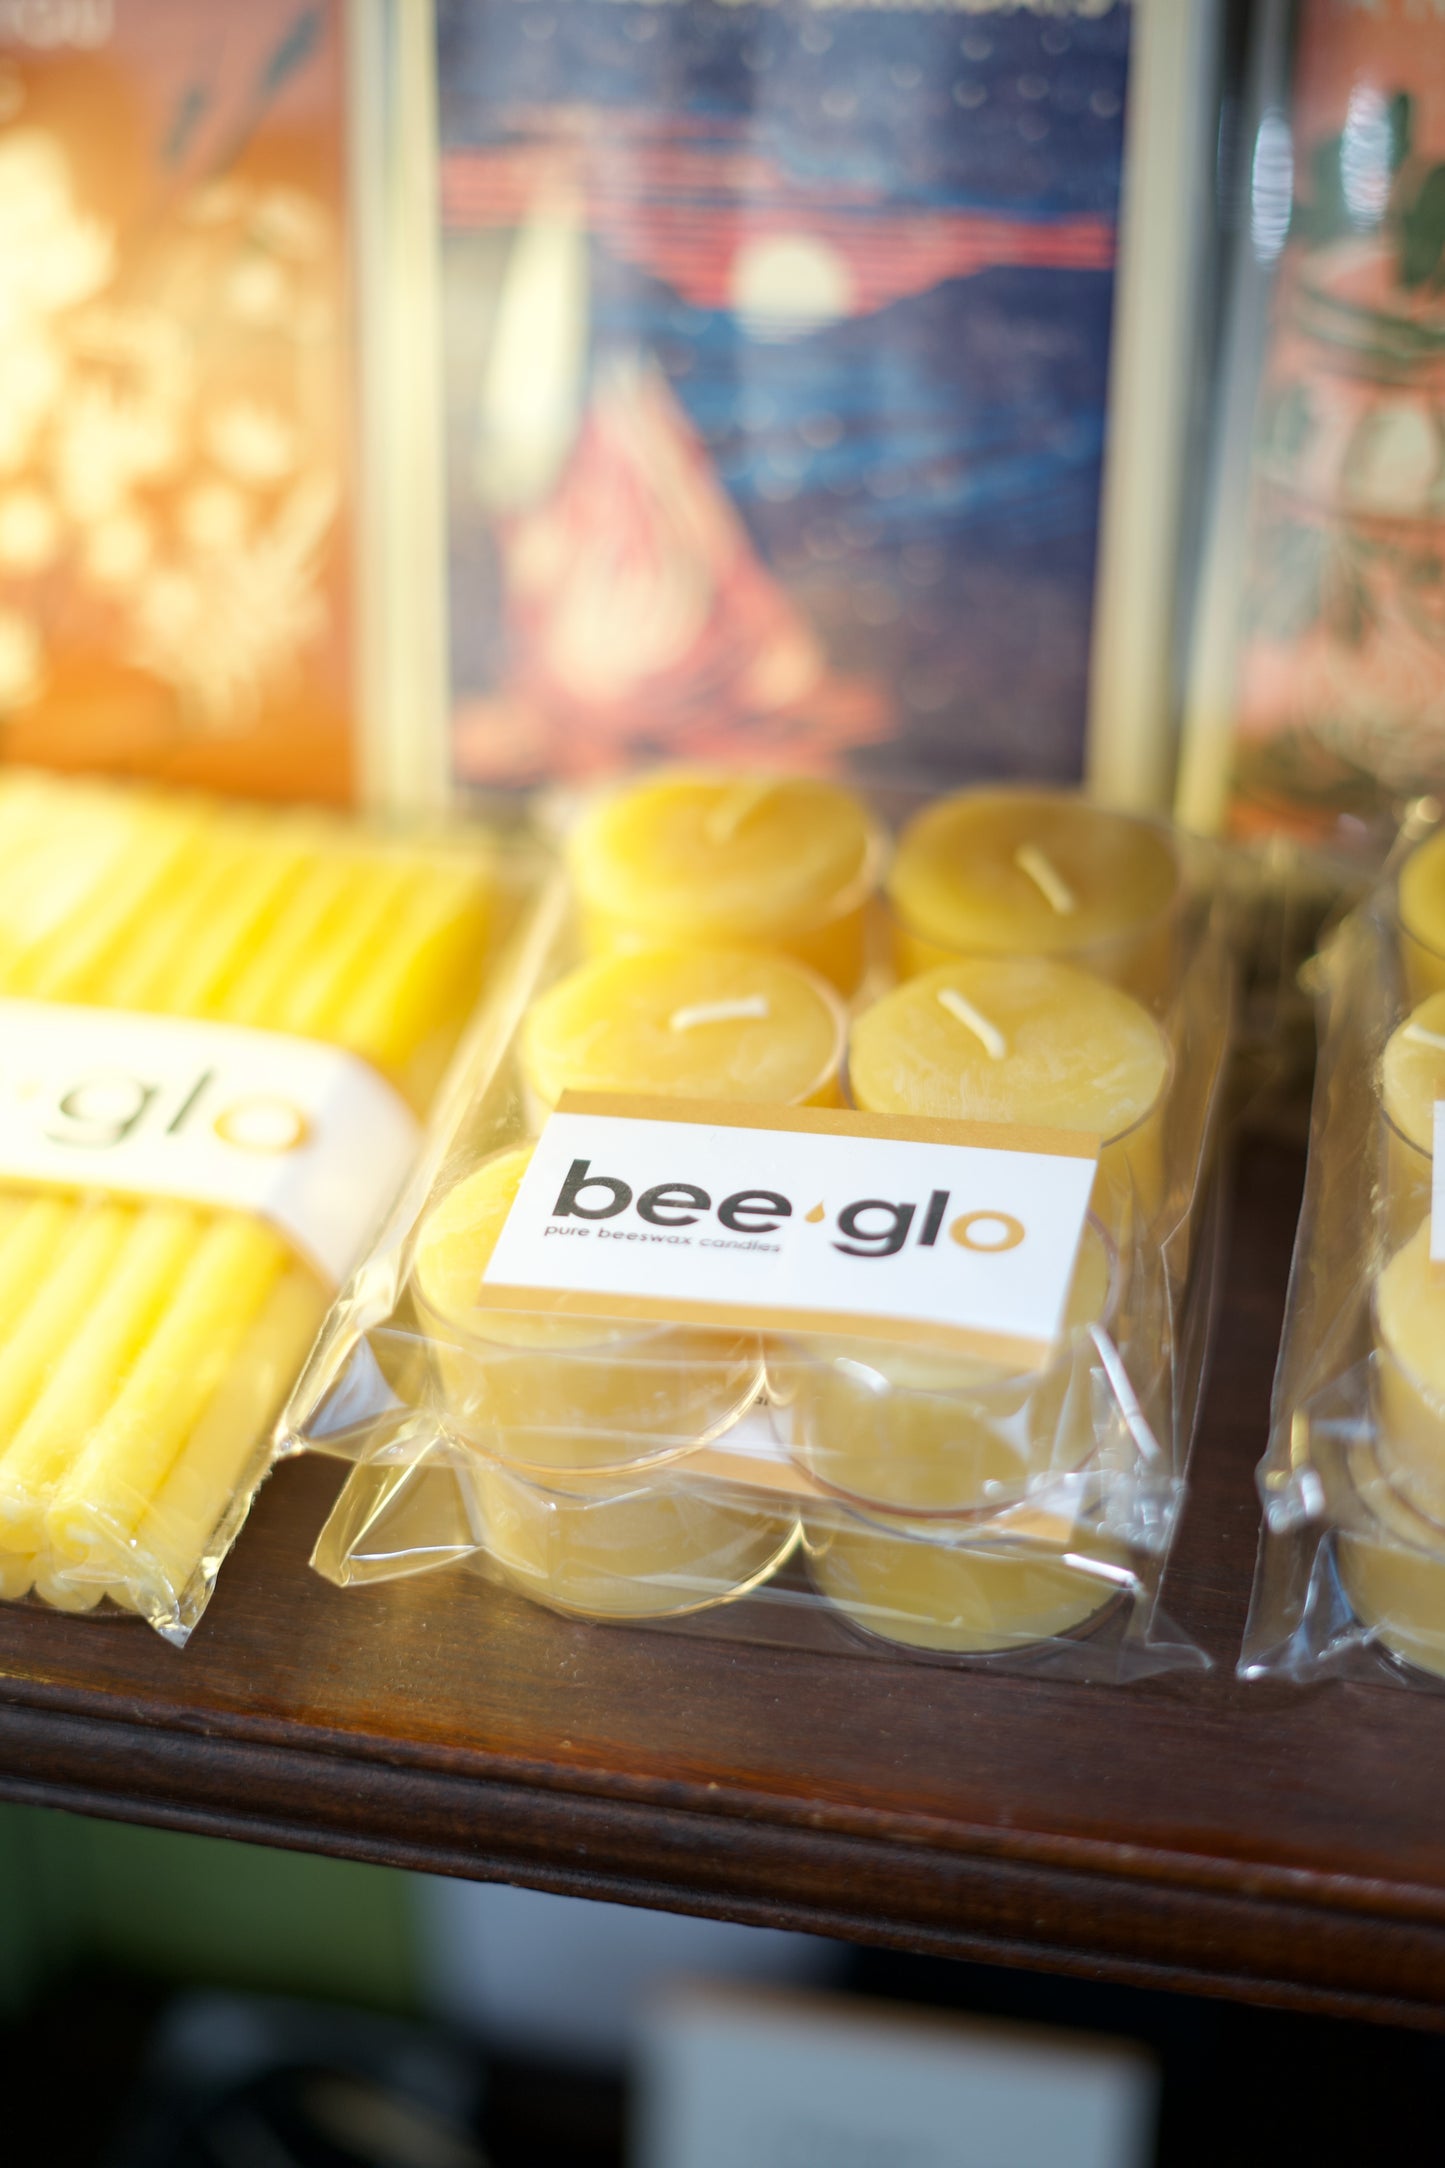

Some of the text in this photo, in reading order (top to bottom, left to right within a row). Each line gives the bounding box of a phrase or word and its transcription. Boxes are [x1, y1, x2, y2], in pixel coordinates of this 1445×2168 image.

[47, 1066, 315, 1150] glo
[543, 1225, 782, 1253] pure beeswax candles
[552, 1158, 1026, 1257] bee glo
